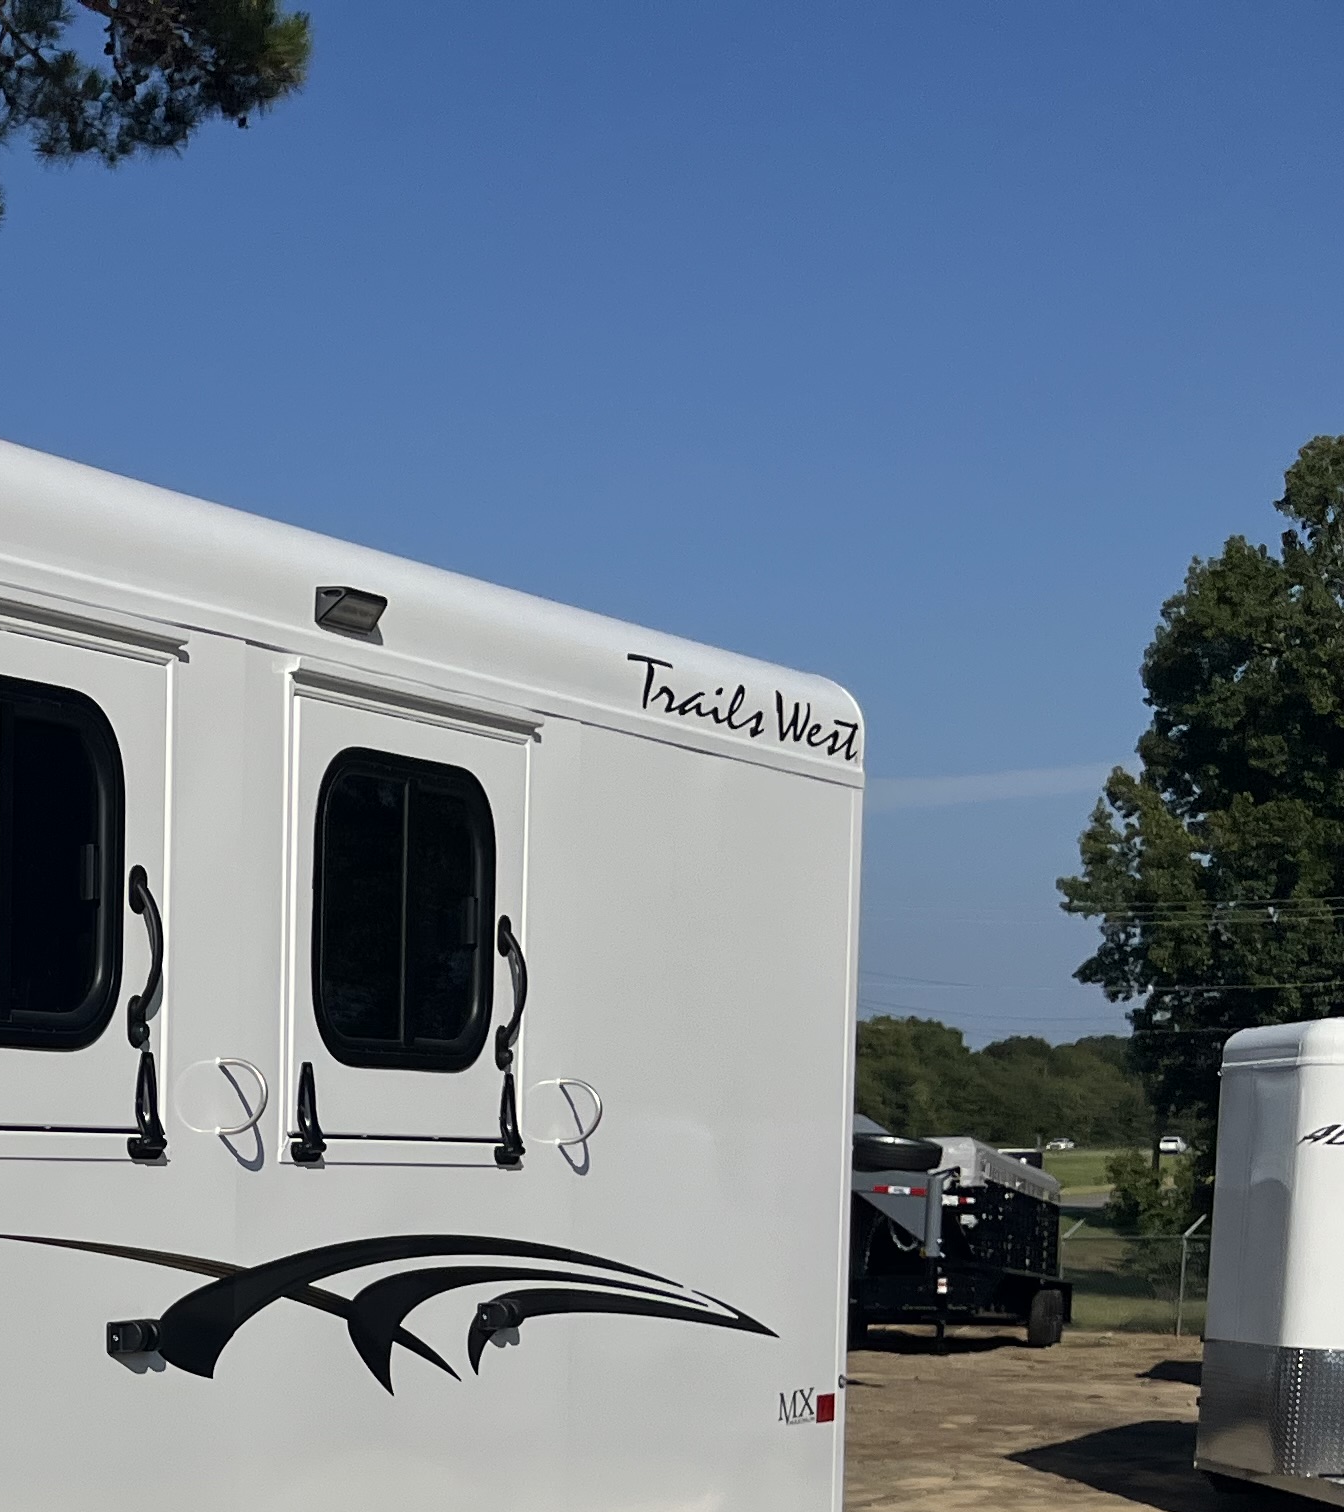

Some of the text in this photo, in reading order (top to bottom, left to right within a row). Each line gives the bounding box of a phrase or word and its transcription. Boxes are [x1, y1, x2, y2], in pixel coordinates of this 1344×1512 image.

[627, 653, 859, 761] Trails West
[778, 1387, 815, 1426] MX
